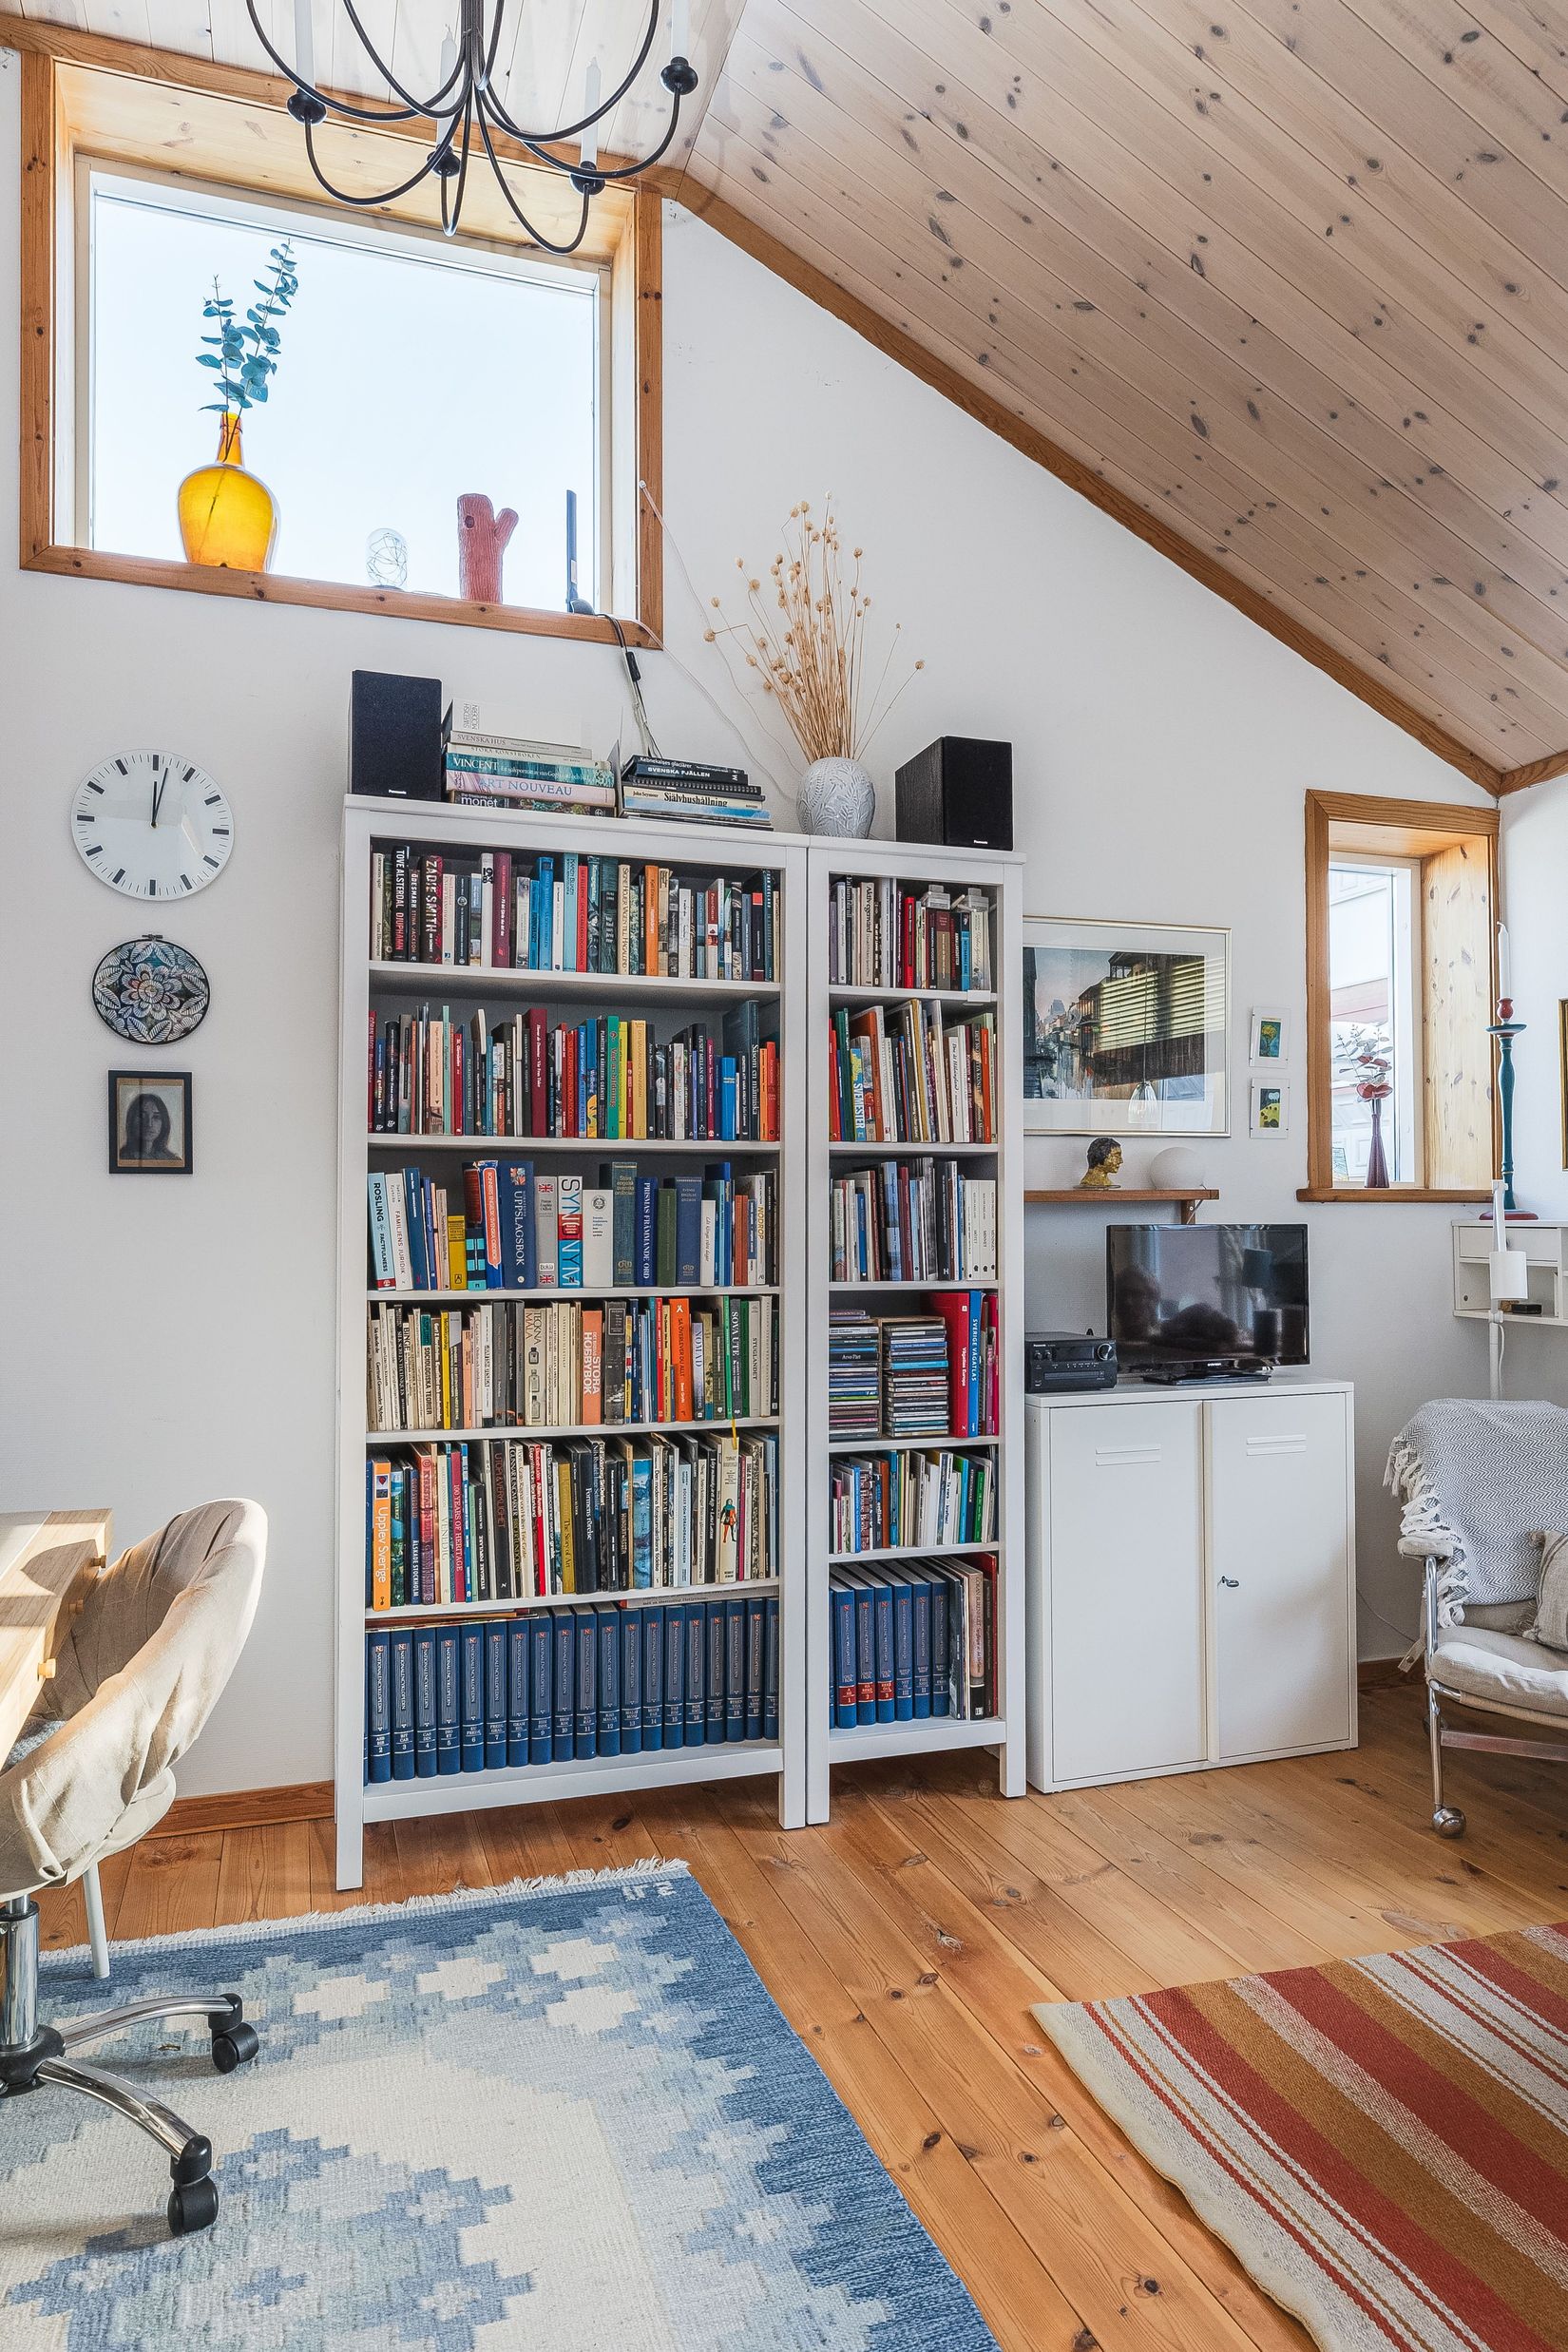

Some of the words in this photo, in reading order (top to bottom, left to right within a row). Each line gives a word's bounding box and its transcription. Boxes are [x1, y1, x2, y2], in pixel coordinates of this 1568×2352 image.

[457, 735, 490, 743] SVENSKA
[453, 756, 498, 771] VINCENT
[680, 769, 710, 777] FJÄLLEN
[461, 795, 498, 807] monet
[478, 777, 505, 789] ART
[508, 780, 572, 796] NOUVEAU
[663, 792, 728, 808] Självhushållning
[395, 850, 405, 868] TOVE
[395, 869, 405, 908] ALSTERDAL
[426, 860, 438, 893] ZADIE
[426, 895, 438, 932] SMITH
[864, 904, 872, 933] egenvård
[395, 911, 405, 950] DJUPHAMN
[752, 1069, 757, 1079] en
[853, 1081, 865, 1128] SVEMESTER
[373, 1182, 384, 1222] ROSLING
[379, 1233, 388, 1272] FACTFULNESS
[514, 1191, 525, 1266] UPPSLAGSBOK
[526, 1312, 535, 1340] MÅLA
[583, 1331, 593, 1395] HOBBYBOK
[592, 1356, 601, 1395] STORA
[376, 1507, 389, 1543] Upplev
[440, 1517, 449, 1560] VENEDIG
[455, 1520, 461, 1531] OF
[377, 1546, 389, 1582] Sverige
